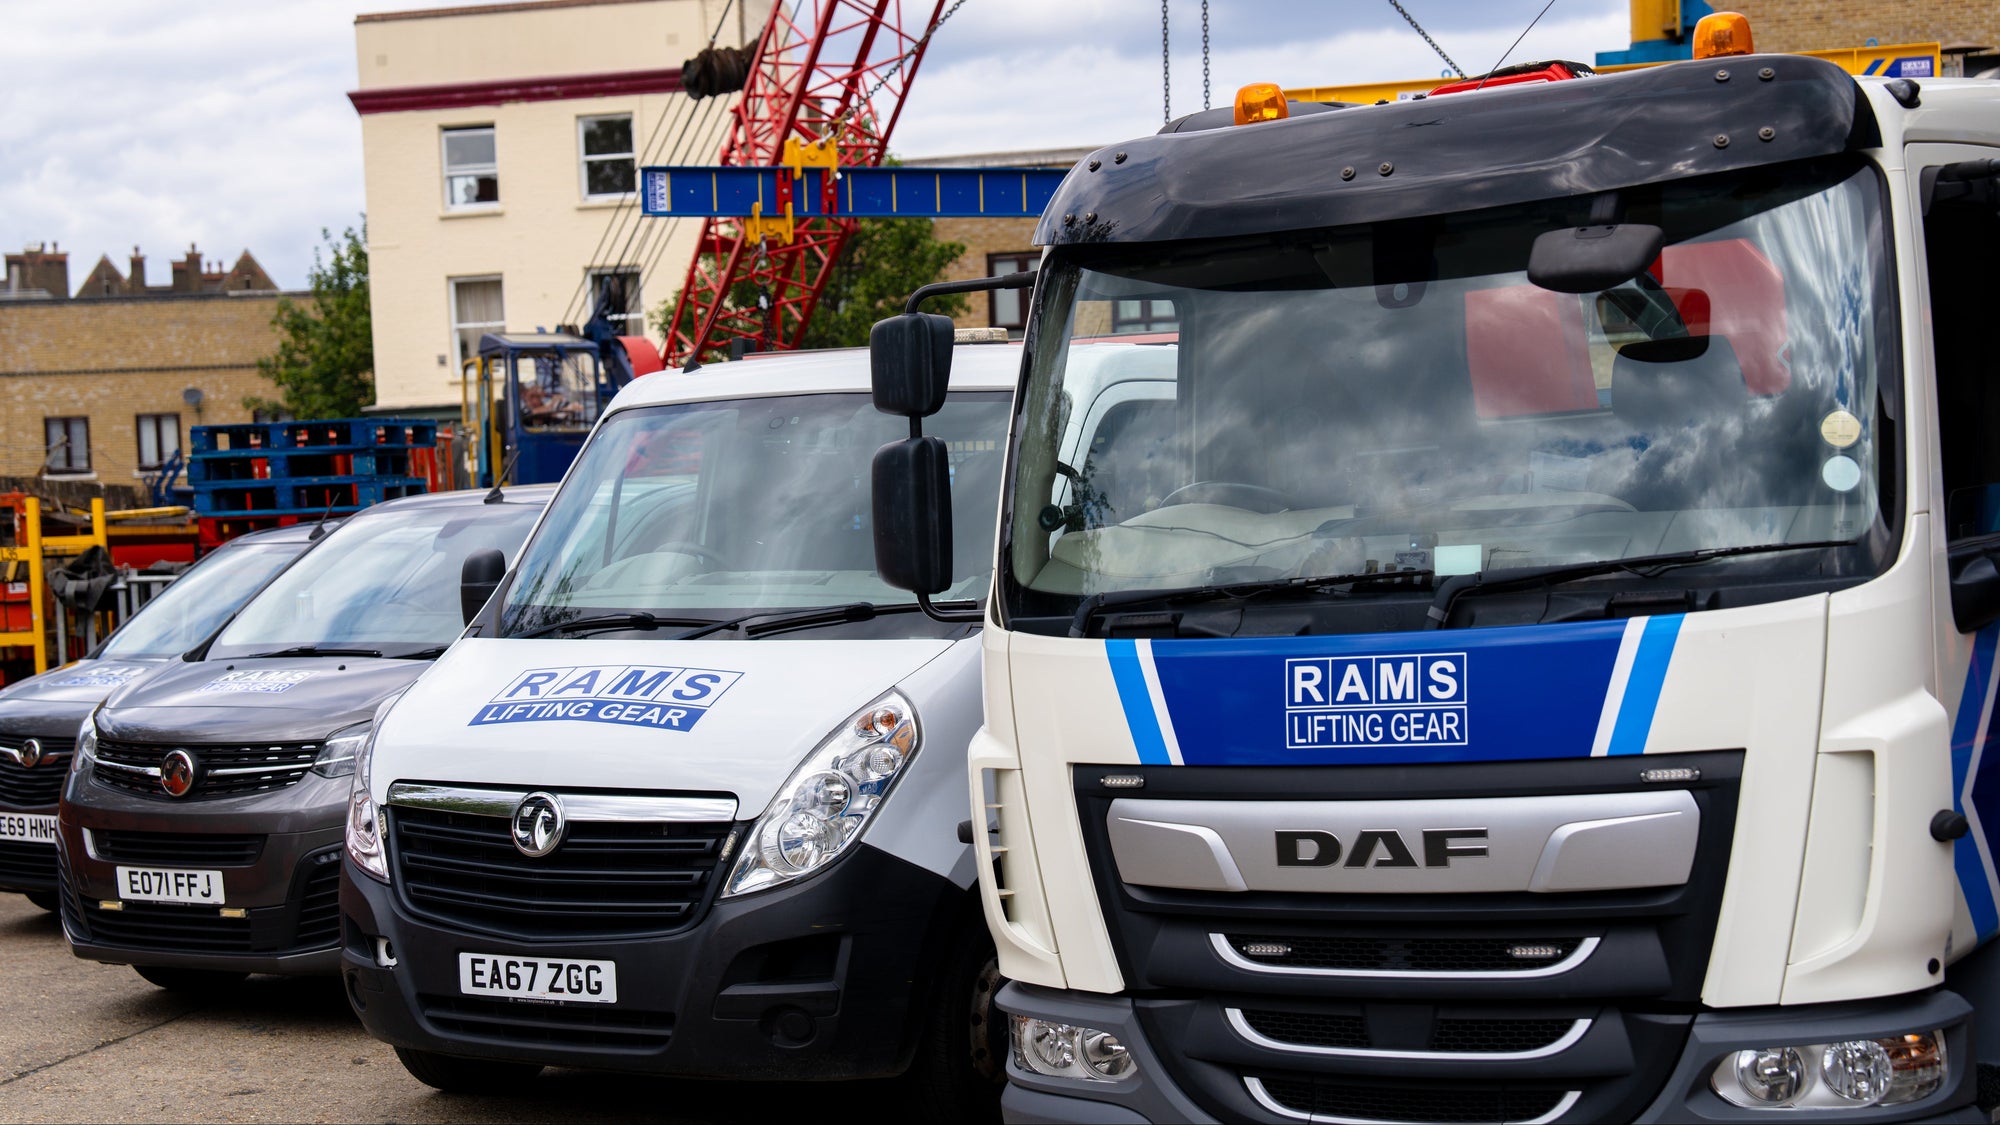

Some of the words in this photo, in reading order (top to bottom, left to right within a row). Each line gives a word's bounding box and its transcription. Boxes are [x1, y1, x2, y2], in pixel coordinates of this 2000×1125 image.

[657, 174, 665, 208] RAMS
[219, 671, 311, 681] RAMS
[504, 669, 721, 701] RAMS
[1294, 660, 1458, 703] RAMS
[482, 701, 593, 722] LIFTING
[598, 704, 688, 727] GEAR
[1294, 713, 1383, 743] LIFTING
[1390, 711, 1460, 741] GEAR
[1275, 827, 1488, 868] DAF
[174, 872, 212, 898] FFJ
[470, 957, 538, 992] EA67
[547, 962, 603, 995] ZGG
